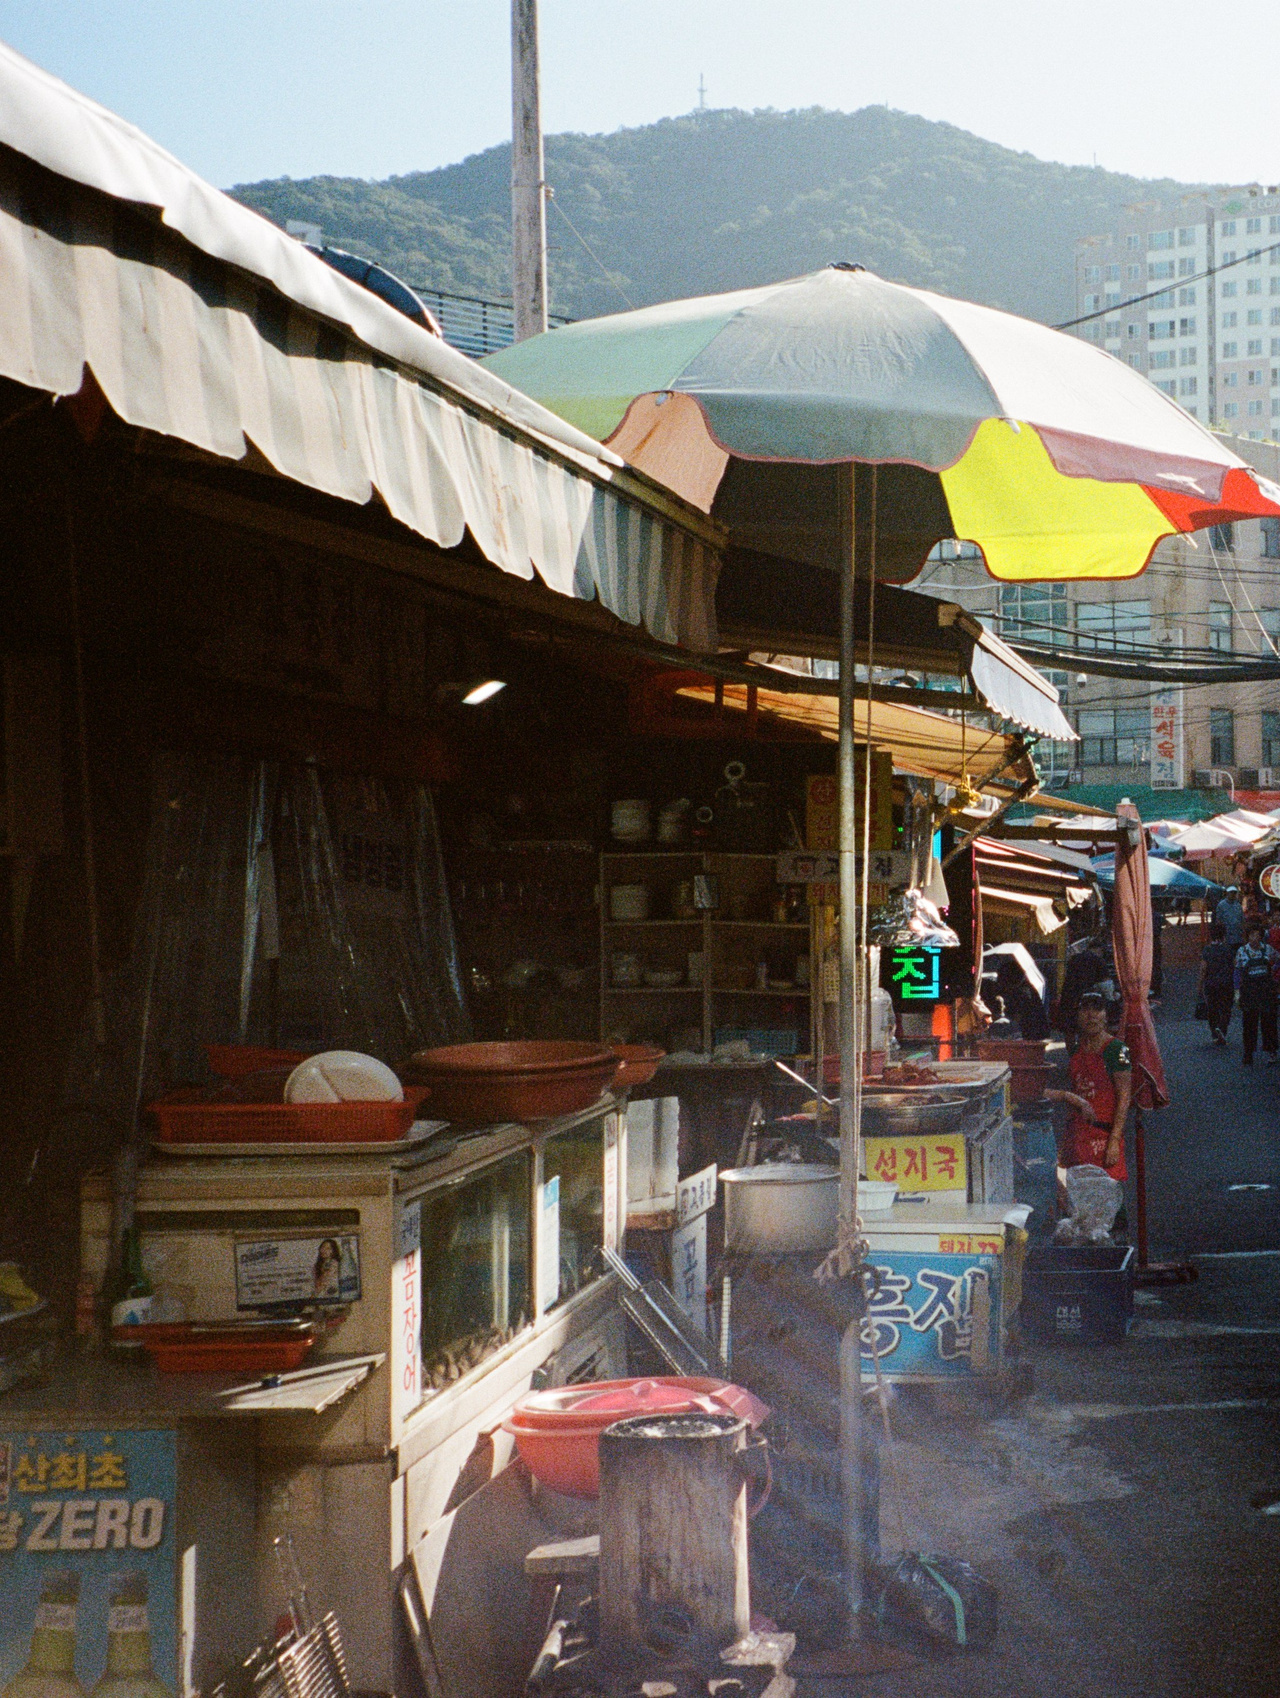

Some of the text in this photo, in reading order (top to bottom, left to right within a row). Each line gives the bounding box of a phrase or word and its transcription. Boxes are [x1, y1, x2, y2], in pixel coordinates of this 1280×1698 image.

[892, 953, 941, 999] 집
[874, 1145, 969, 1182] 선지국
[26, 1497, 166, 1551] ZERO
